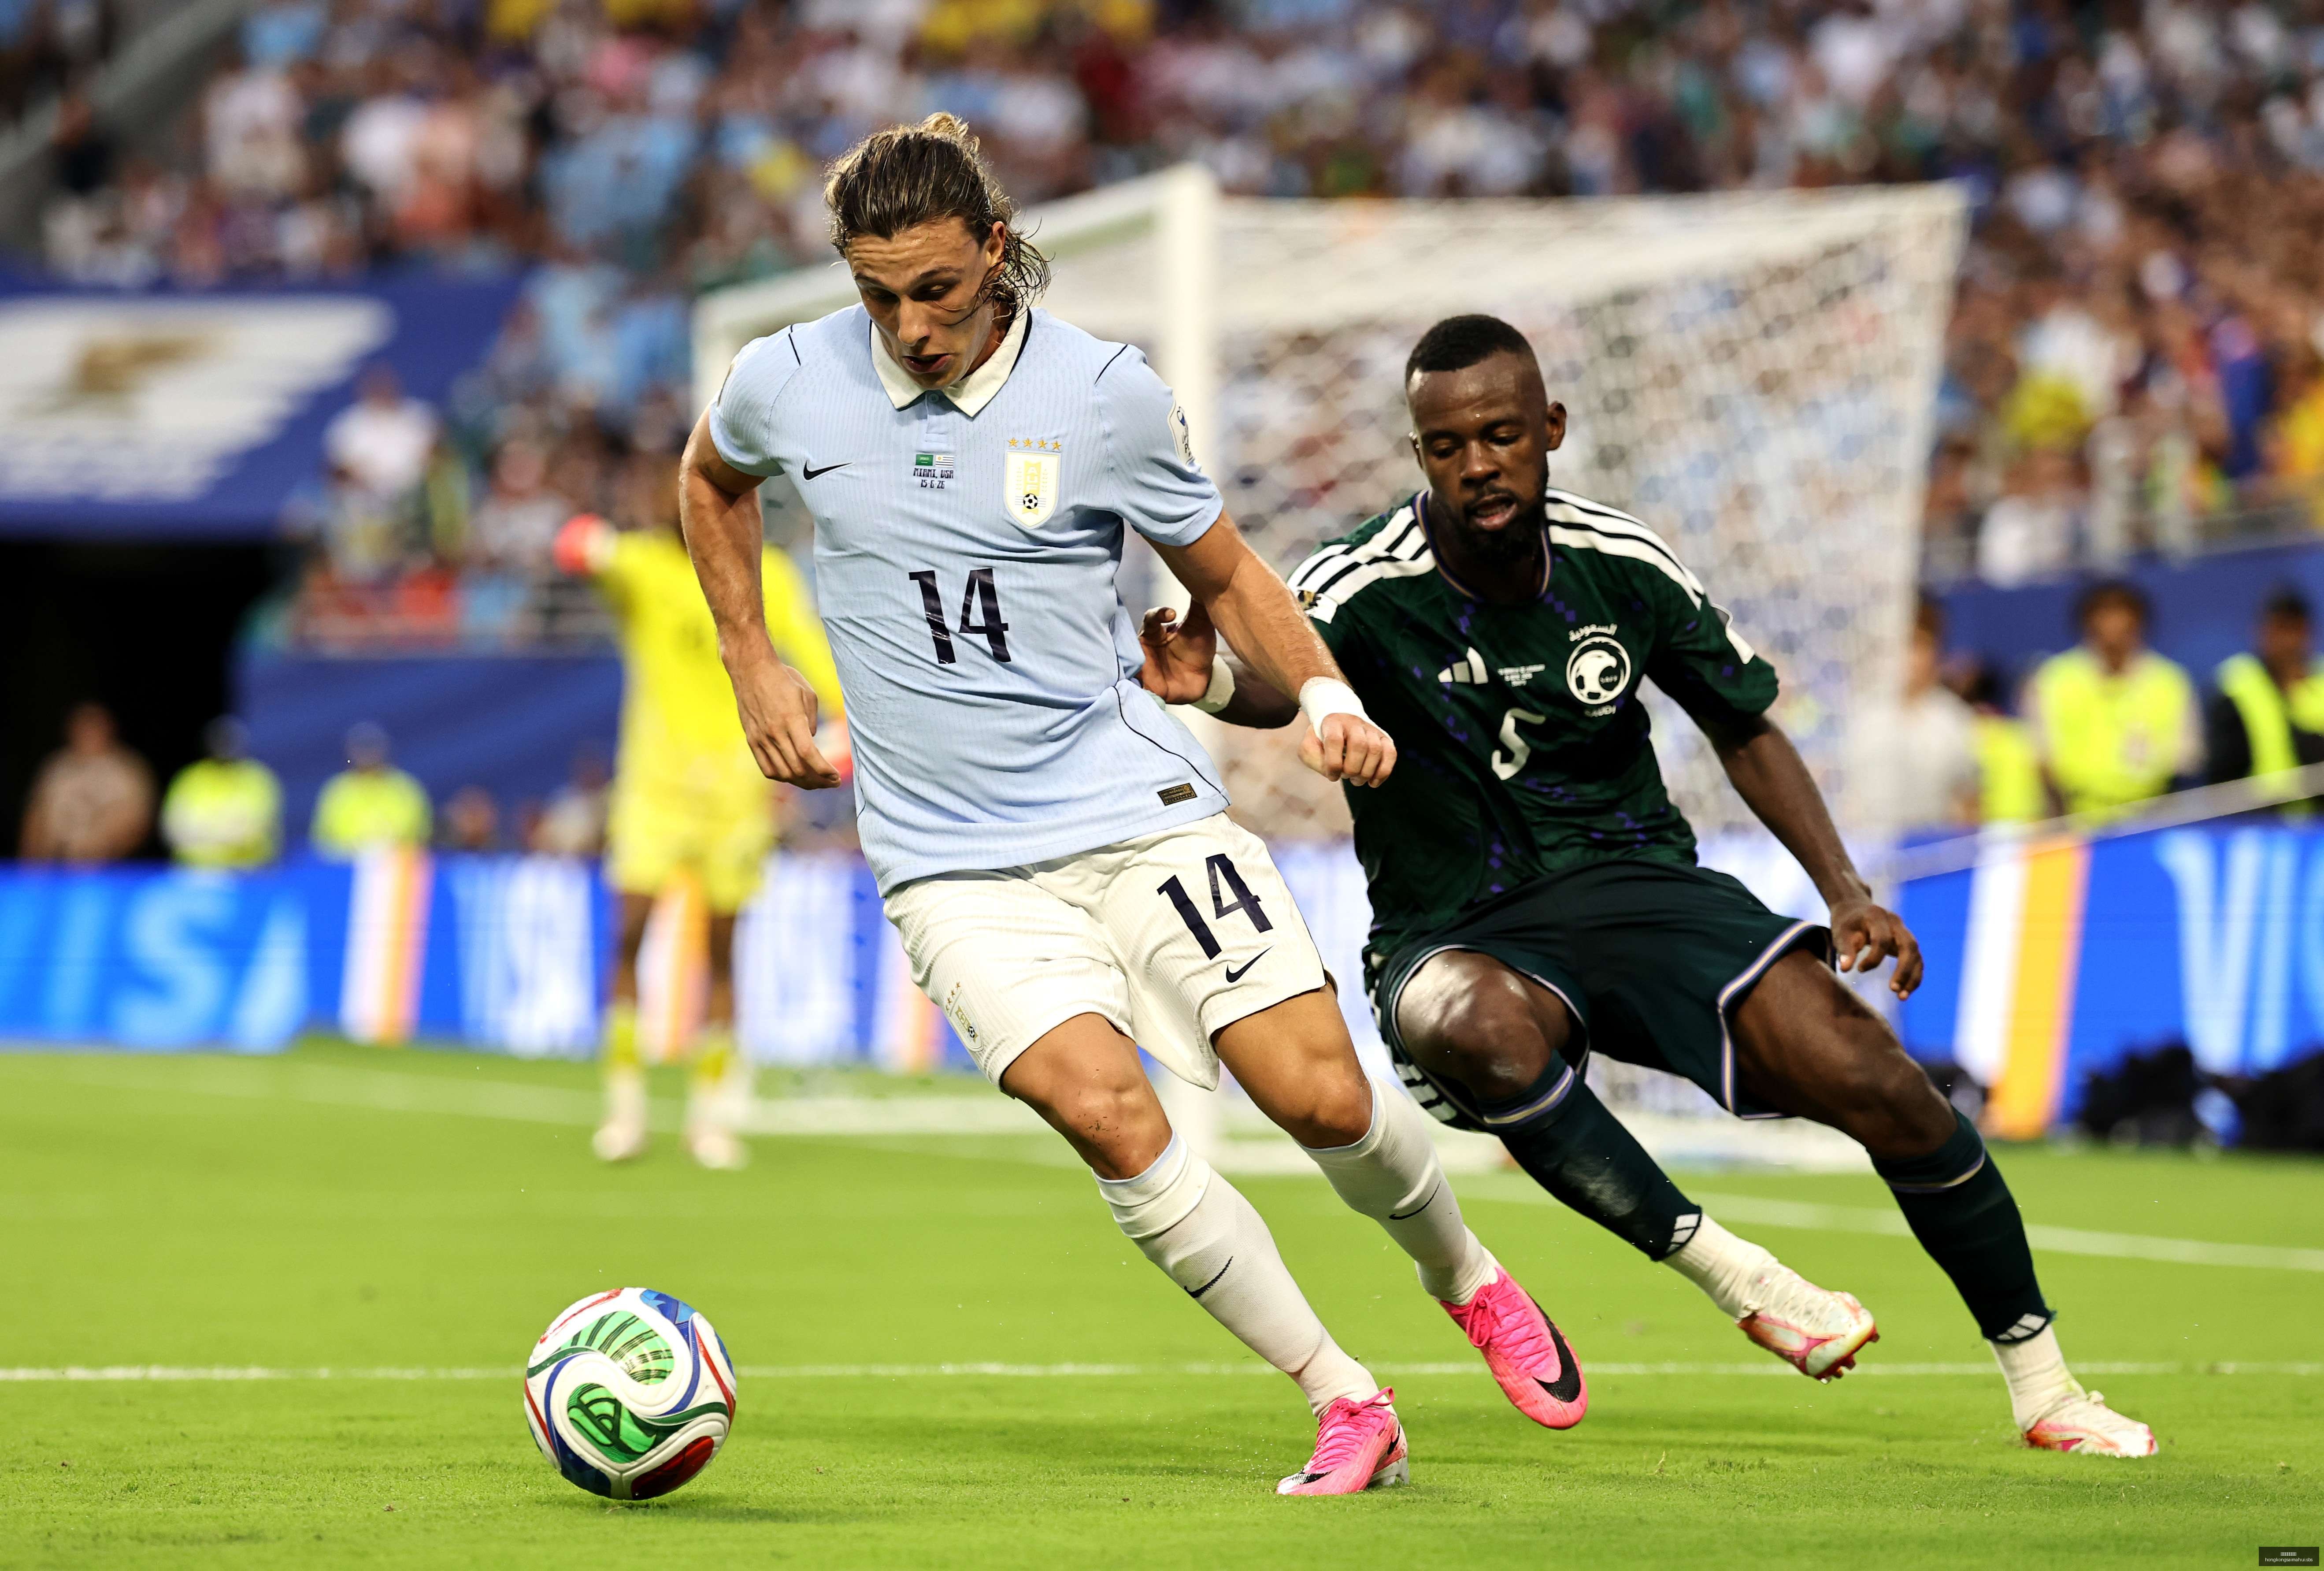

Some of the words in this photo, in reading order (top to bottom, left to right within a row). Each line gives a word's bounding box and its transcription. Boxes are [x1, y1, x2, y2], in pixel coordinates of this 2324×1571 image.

[913, 468, 938, 479] MIAMI,
[941, 469, 953, 479] USA
[908, 568, 1012, 664] 14
[1568, 623, 1618, 642] السعودية
[1491, 707, 1546, 781] 5
[1157, 853, 1274, 960] 14
